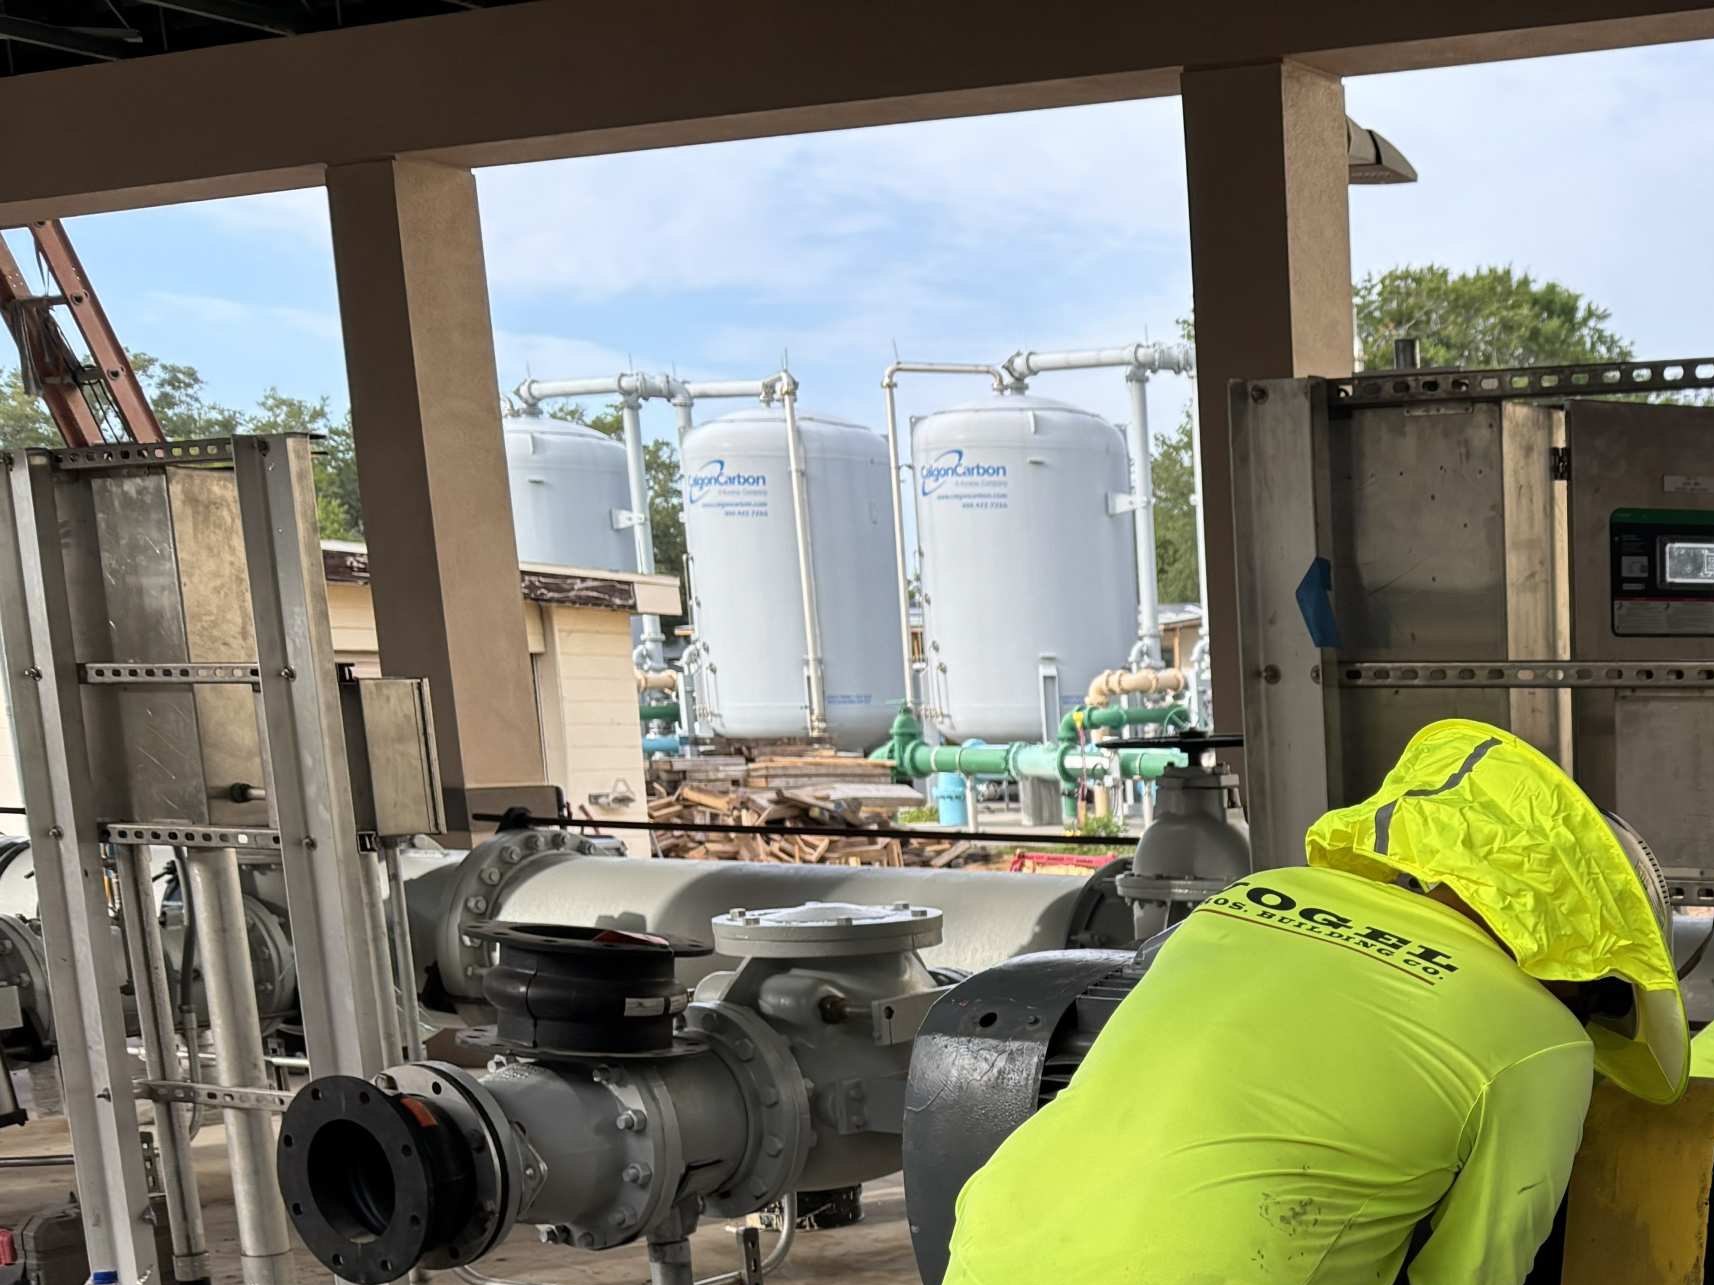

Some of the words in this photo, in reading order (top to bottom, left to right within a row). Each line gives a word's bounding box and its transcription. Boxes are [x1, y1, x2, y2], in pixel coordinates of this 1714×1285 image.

[1223, 881, 1460, 974] OGEL
[1256, 909, 1396, 958] BUILDING
[1402, 957, 1446, 981] CO.
